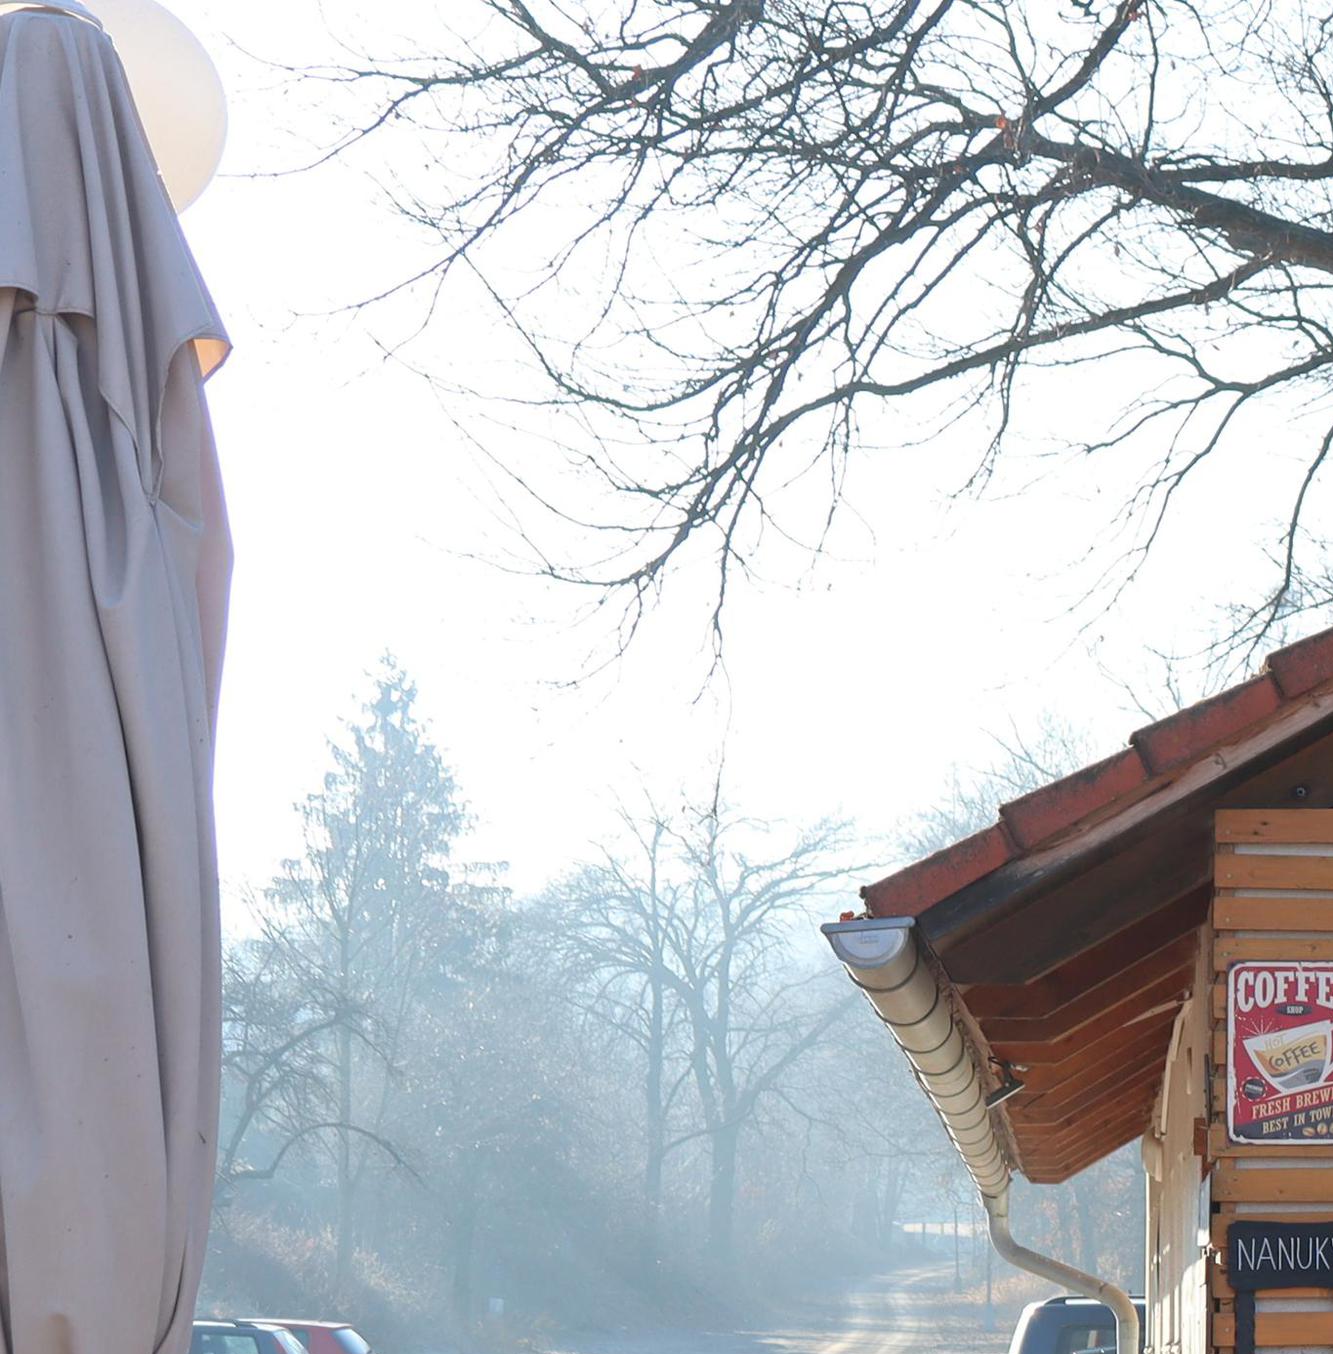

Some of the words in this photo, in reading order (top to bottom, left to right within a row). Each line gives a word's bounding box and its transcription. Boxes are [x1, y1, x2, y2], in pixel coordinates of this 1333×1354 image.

[1286, 1005, 1304, 1014] SHOP
[1252, 1097, 1292, 1120] FRESH
[1262, 1116, 1289, 1135] BEST
[1294, 1112, 1306, 1127] IN
